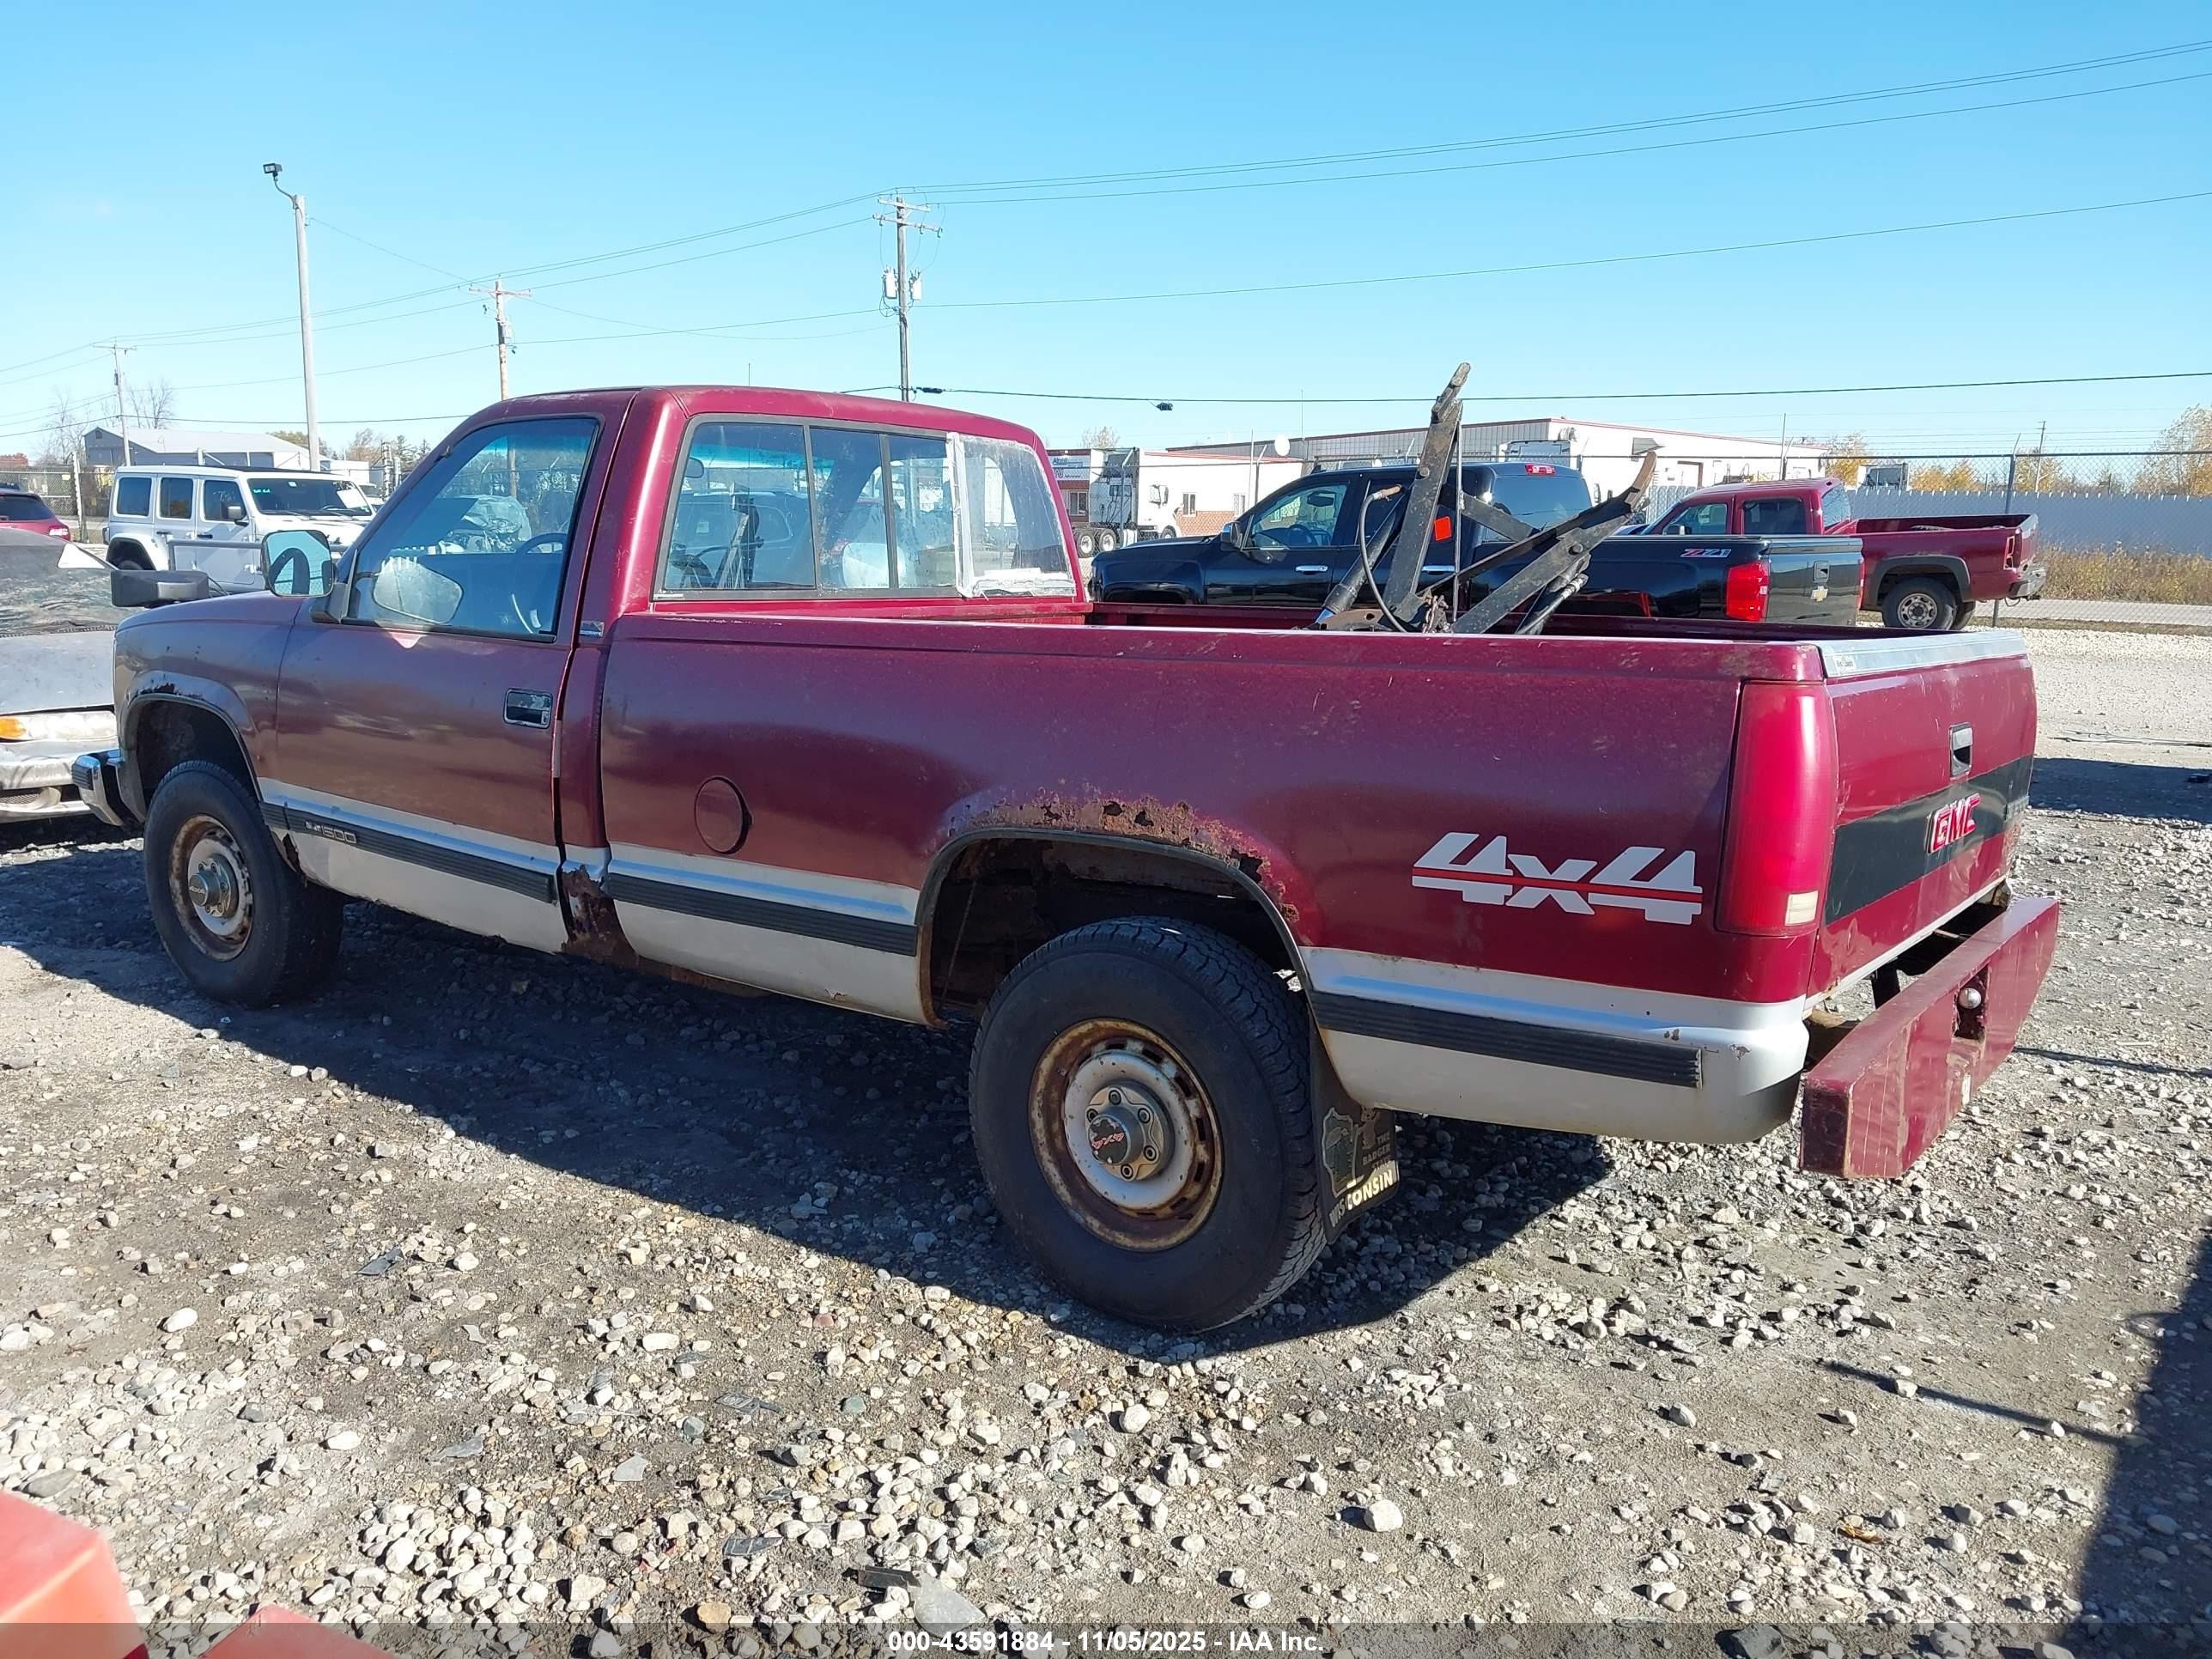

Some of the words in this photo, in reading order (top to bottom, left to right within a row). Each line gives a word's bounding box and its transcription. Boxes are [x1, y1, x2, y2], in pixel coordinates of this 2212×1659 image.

[1680, 548, 1732, 558] Z71
[1930, 793, 1982, 853] GMC
[1362, 1143, 1390, 1166] BADGER
